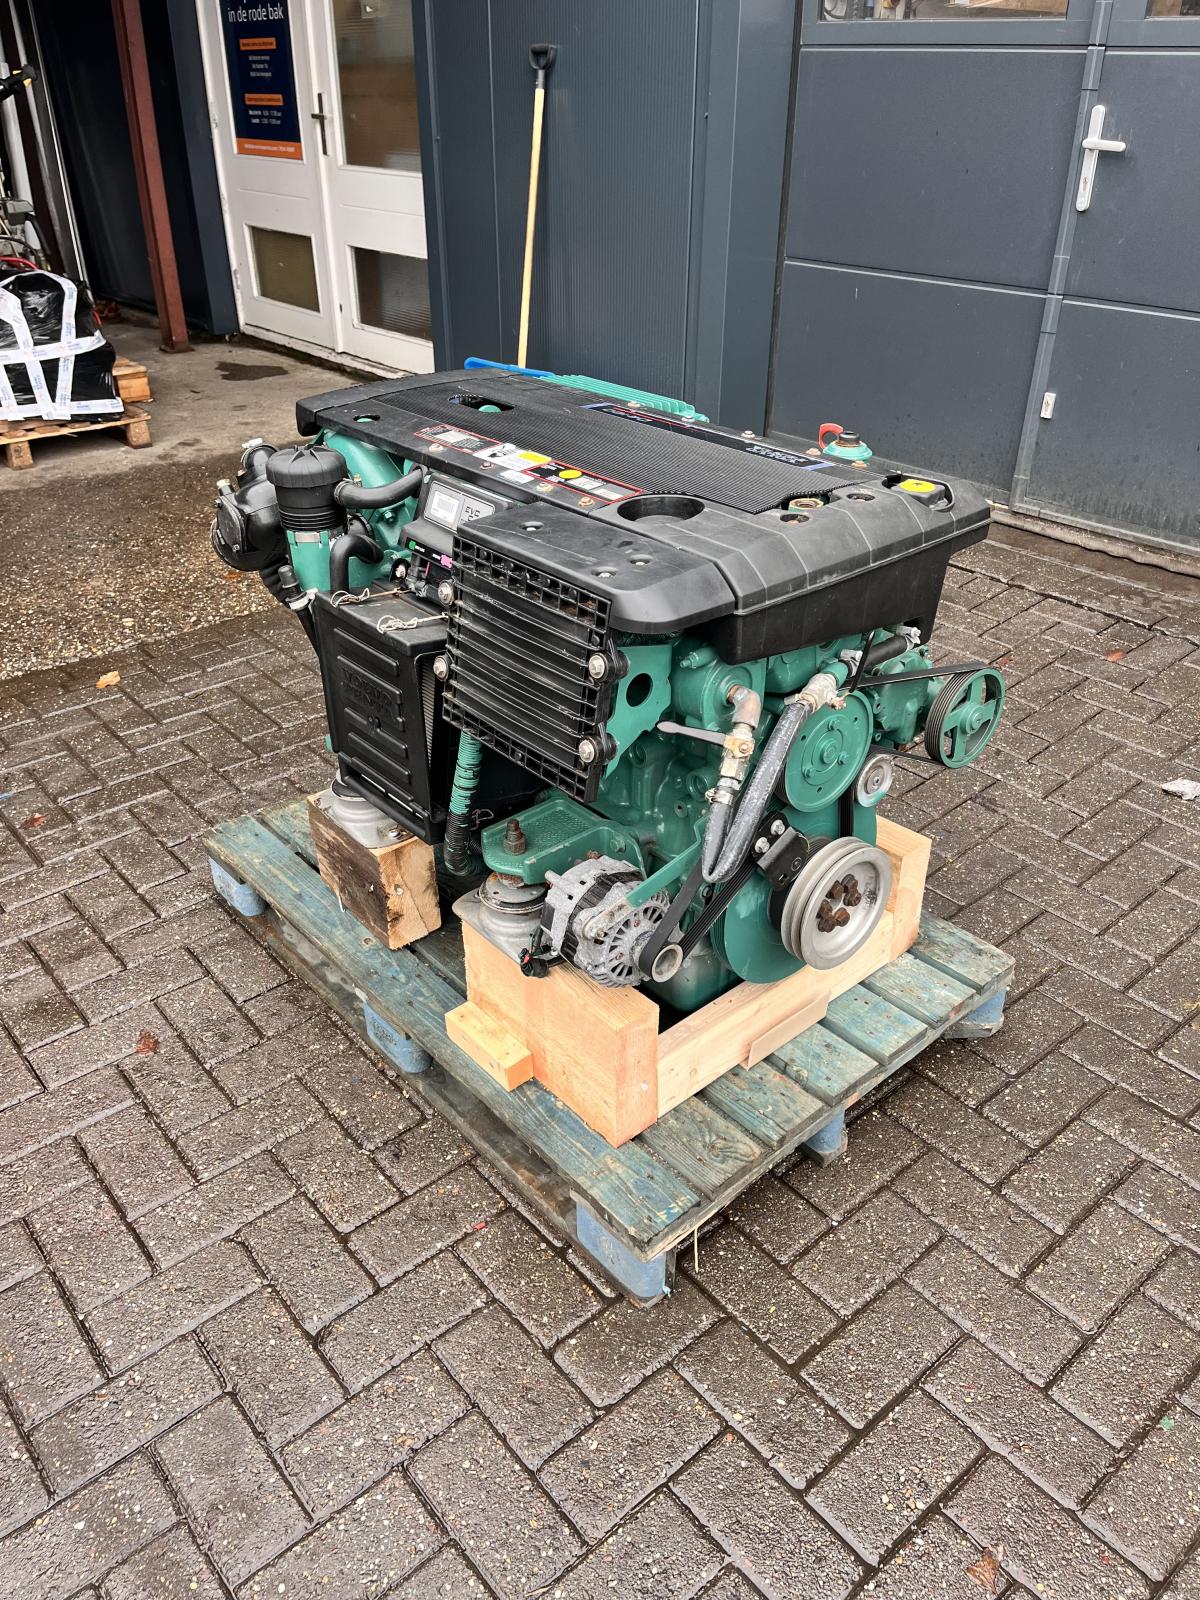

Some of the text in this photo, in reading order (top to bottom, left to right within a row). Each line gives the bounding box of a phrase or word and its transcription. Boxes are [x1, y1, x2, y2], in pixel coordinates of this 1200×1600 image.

[227, 2, 284, 23] in de rode bak
